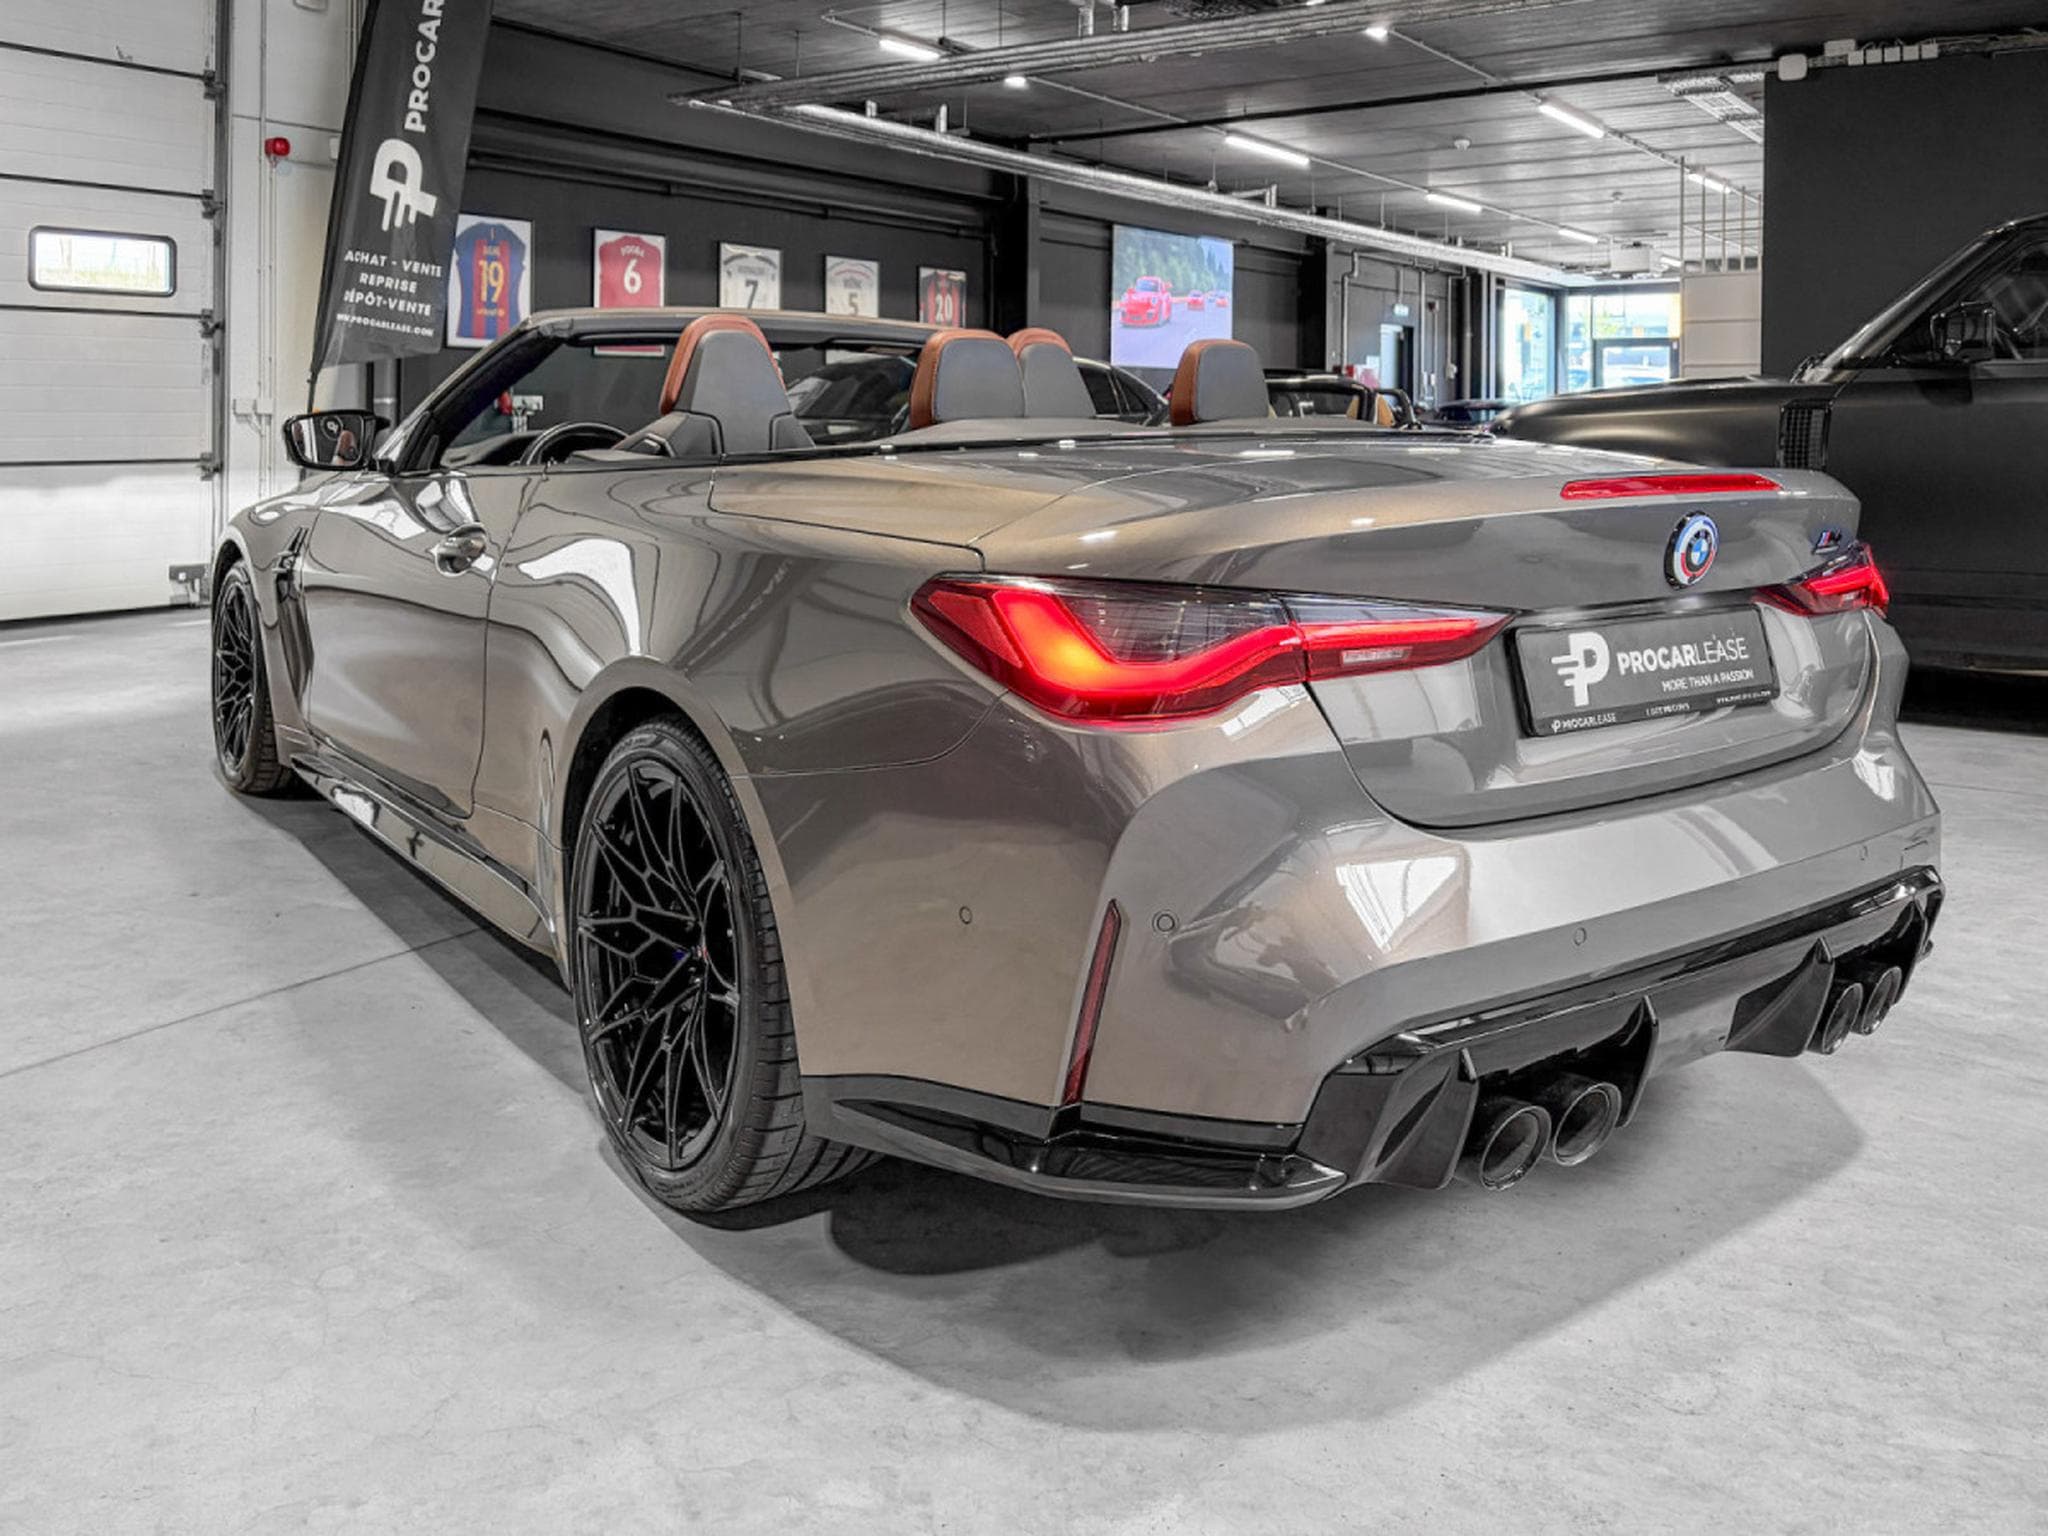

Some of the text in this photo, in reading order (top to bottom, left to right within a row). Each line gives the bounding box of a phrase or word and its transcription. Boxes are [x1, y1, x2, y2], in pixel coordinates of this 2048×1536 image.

[404, 0, 446, 133] PROCAR
[344, 250, 388, 268] ACHAT
[402, 259, 442, 277] VENTE
[623, 257, 643, 295] 6
[359, 272, 418, 294] REPRISE
[478, 259, 504, 303] 19
[745, 279, 759, 309] 7
[848, 292, 859, 315] 5
[935, 293, 953, 324] 20
[1616, 637, 1749, 676] PROCARLEASE
[1662, 668, 1754, 692] MORE THAN A PASSION
